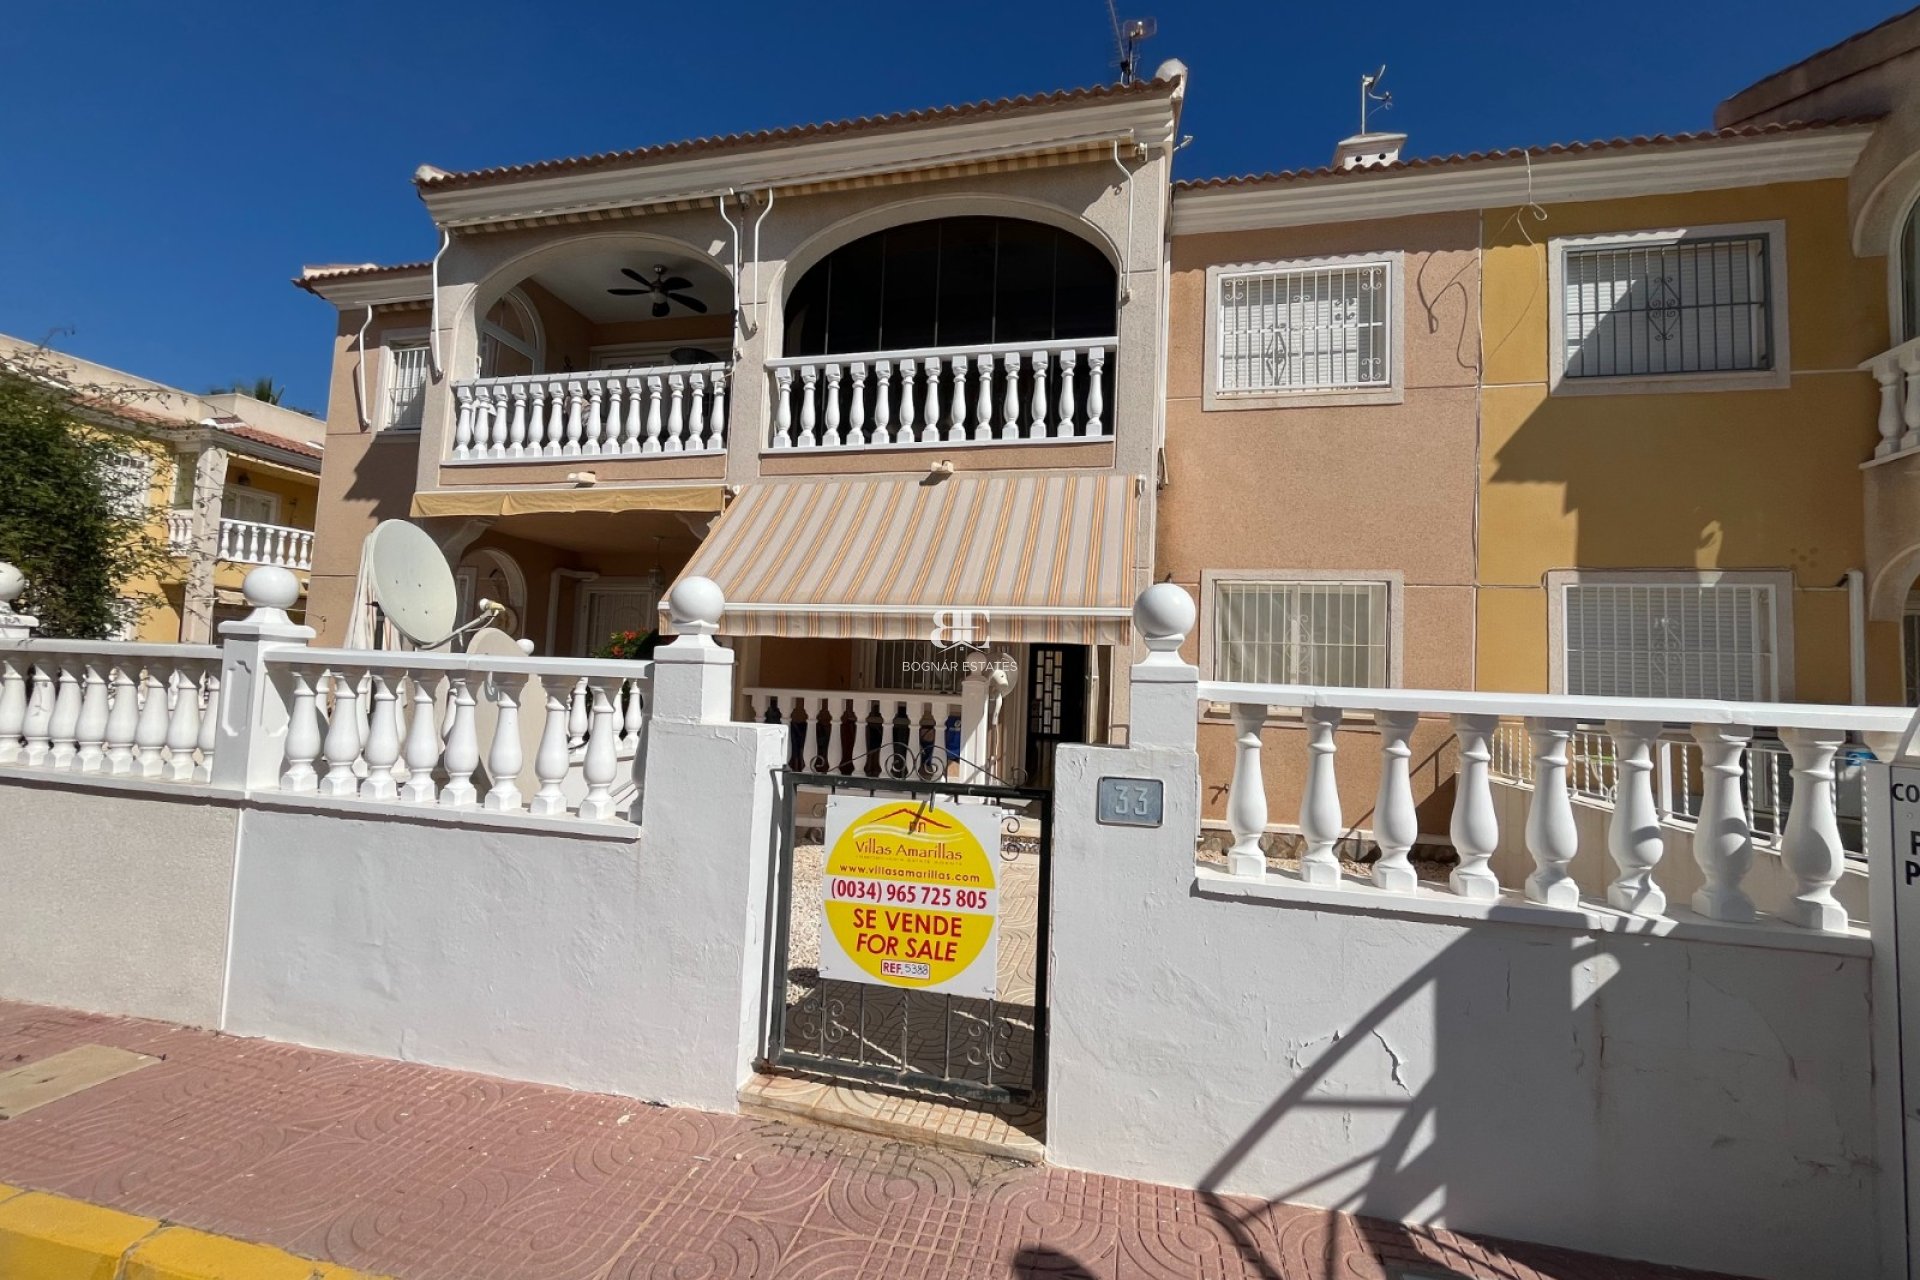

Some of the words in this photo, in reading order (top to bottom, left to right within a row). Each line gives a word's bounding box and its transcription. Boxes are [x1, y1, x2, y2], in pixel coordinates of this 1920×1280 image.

[1115, 785, 1148, 815] 33
[856, 838, 892, 855] Villas
[895, 843, 963, 861] Amarillas
[839, 864, 980, 883] www.villasamarillas.com
[831, 878, 882, 903] (0034)
[887, 884, 916, 902] 965
[921, 886, 950, 906] 725
[956, 889, 987, 909] 805
[853, 908, 876, 929] SE
[885, 911, 962, 938] VENDE
[856, 933, 898, 956] FOR
[905, 937, 958, 962] SALE
[883, 962, 903, 975] REF.
